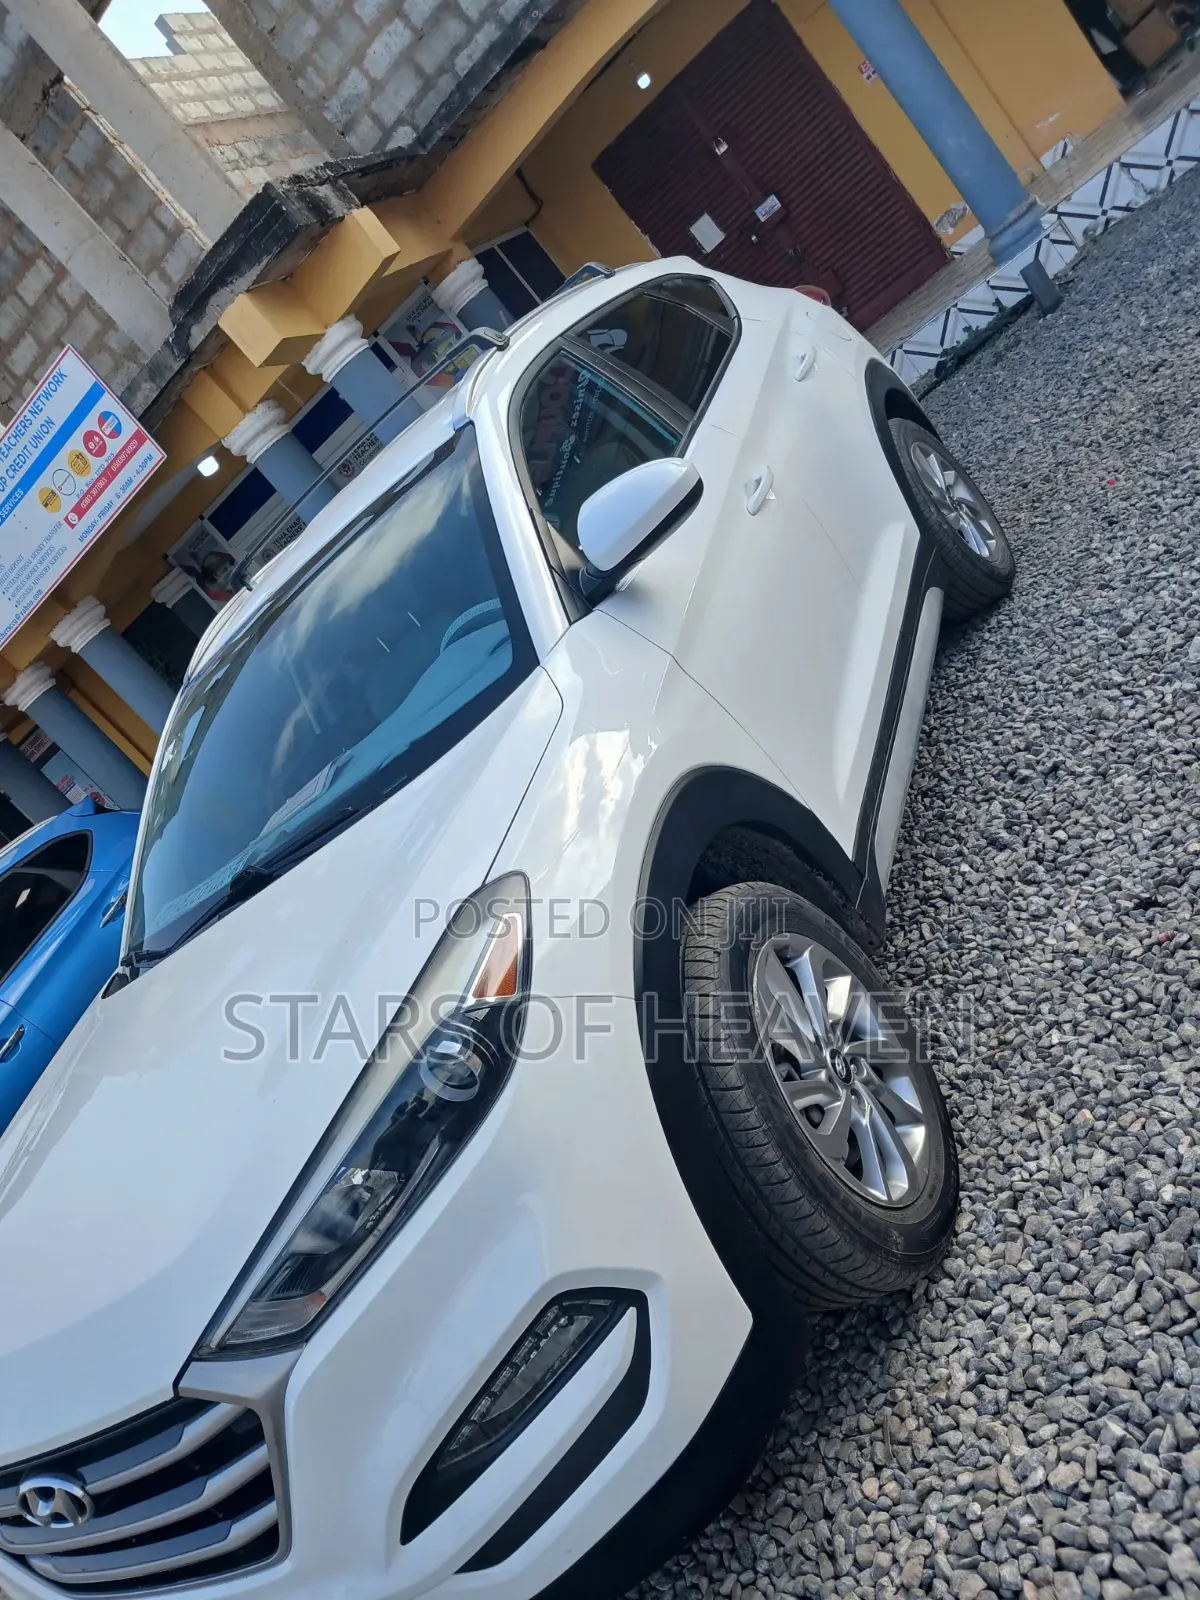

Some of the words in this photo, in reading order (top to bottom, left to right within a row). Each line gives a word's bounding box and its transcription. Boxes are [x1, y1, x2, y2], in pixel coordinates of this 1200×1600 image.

[28, 368, 68, 419] NETWORK
[5, 445, 32, 479] CREDIT
[28, 416, 55, 449] UNION
[0, 488, 24, 518] SERVICES
[97, 499, 115, 521] FRIDAY
